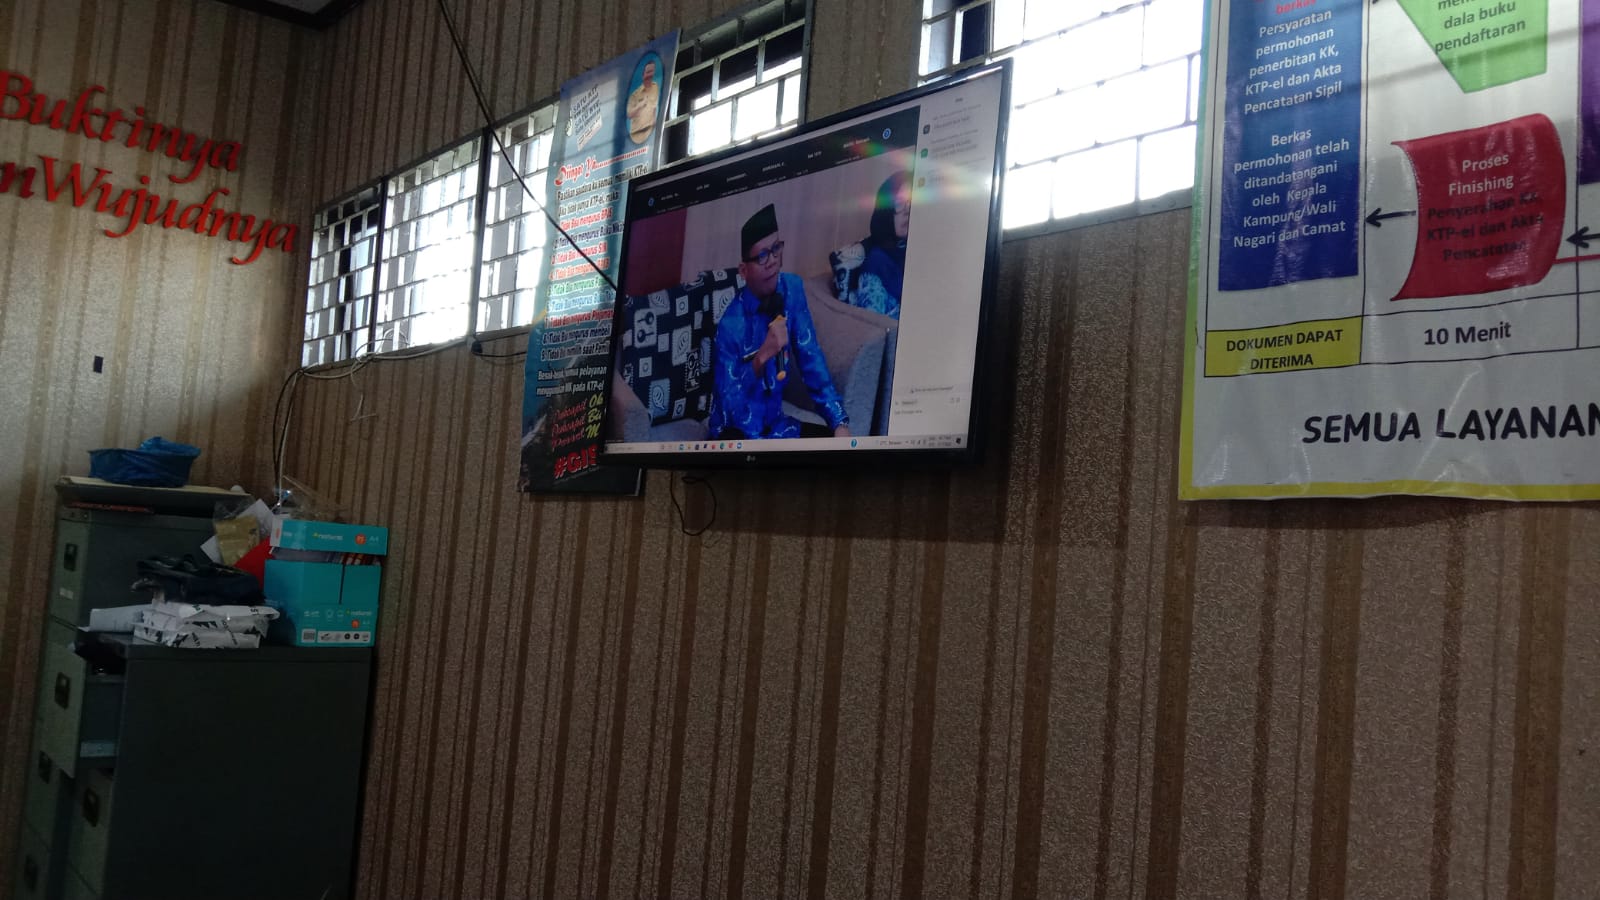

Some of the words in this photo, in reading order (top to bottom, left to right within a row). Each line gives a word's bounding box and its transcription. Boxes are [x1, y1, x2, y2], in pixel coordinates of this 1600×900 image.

[1259, 10, 1332, 37] Persyaratan
[1444, 12, 1475, 29] dala
[1479, 2, 1516, 21] buku
[1256, 28, 1334, 59] permohonan
[1435, 20, 1526, 55] pendaftaran
[1249, 52, 1316, 79] penerbitan
[1319, 44, 1339, 60] KK,
[1245, 76, 1284, 96] KTP-el
[1287, 73, 1310, 87] dan
[1313, 64, 1342, 80] Akta
[1244, 91, 1313, 115] Pencatatan
[1315, 80, 1342, 98] Sipil
[0, 70, 243, 184] Buktinya
[1271, 129, 1312, 147] Berkas
[1234, 148, 1312, 174] permohonan
[1315, 138, 1350, 155] telah
[1462, 154, 1509, 173] Proses
[1244, 160, 1338, 189] ditandatangani
[1448, 175, 1514, 196] Finishing
[1252, 192, 1280, 207] oleh
[1287, 182, 1327, 202] Kepala
[1243, 200, 1336, 228] Kampung/Wali
[1233, 231, 1275, 249] Nagari
[1278, 229, 1299, 242] dan
[1302, 220, 1346, 236] Camat
[1226, 334, 1293, 352] DOKUMEN
[1296, 329, 1343, 345] DAPAT
[1424, 328, 1449, 345] 10
[1455, 321, 1512, 344] Menit
[1250, 354, 1314, 370] DITERIMA
[1302, 411, 1422, 444] SEMUA
[1436, 402, 1600, 442] LAYANAN
